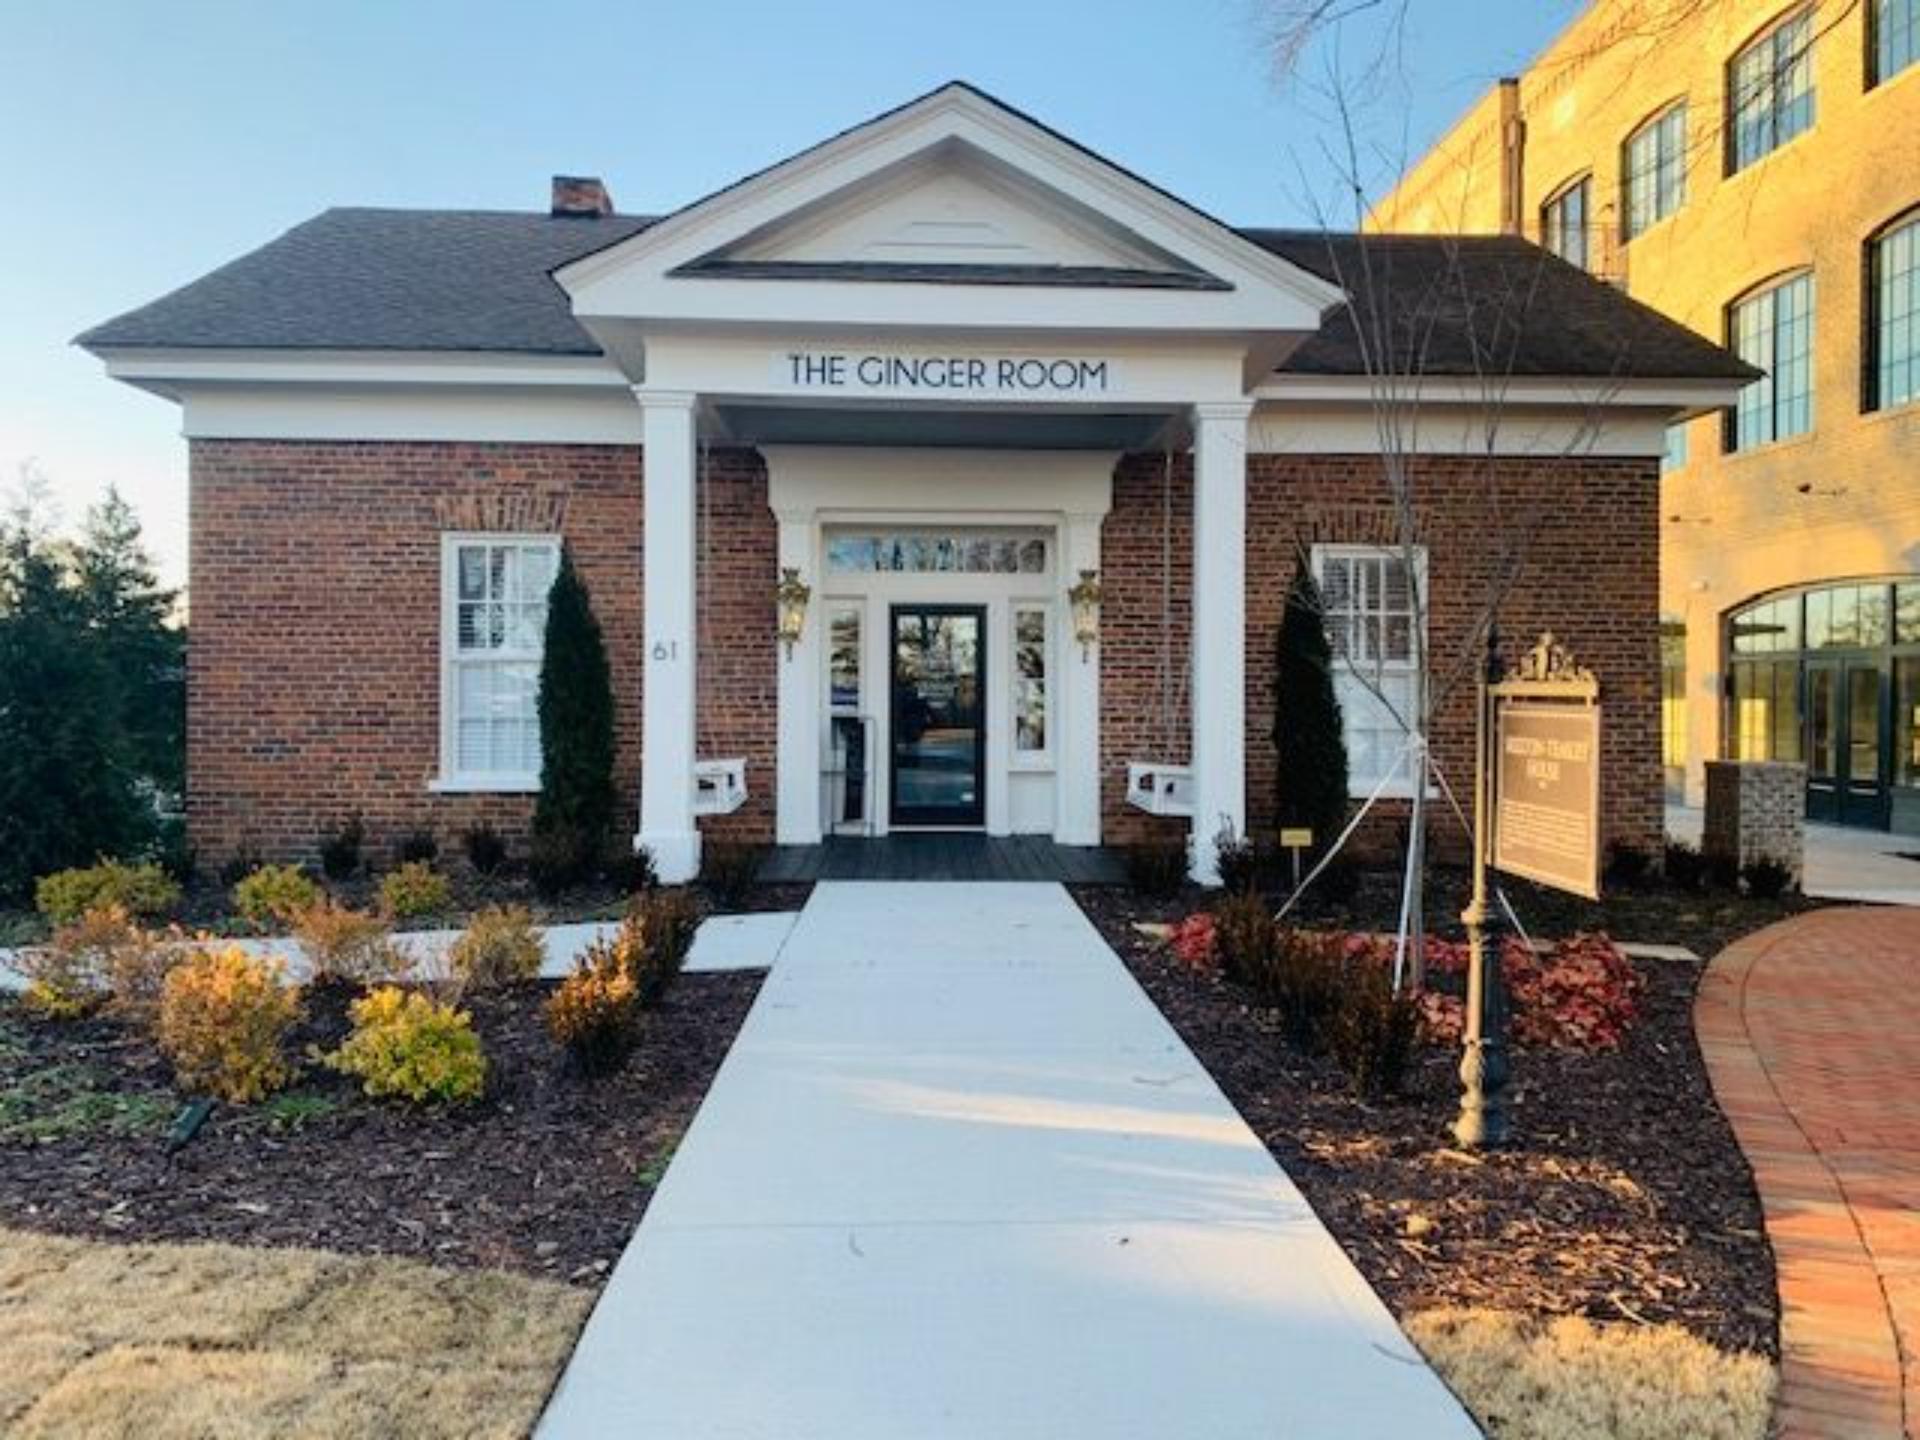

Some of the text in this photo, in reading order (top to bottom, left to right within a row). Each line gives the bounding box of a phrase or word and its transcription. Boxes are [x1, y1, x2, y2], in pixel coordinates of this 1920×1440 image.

[788, 354, 1107, 390] THE GINGER ROOM
[653, 640, 677, 661] 61
